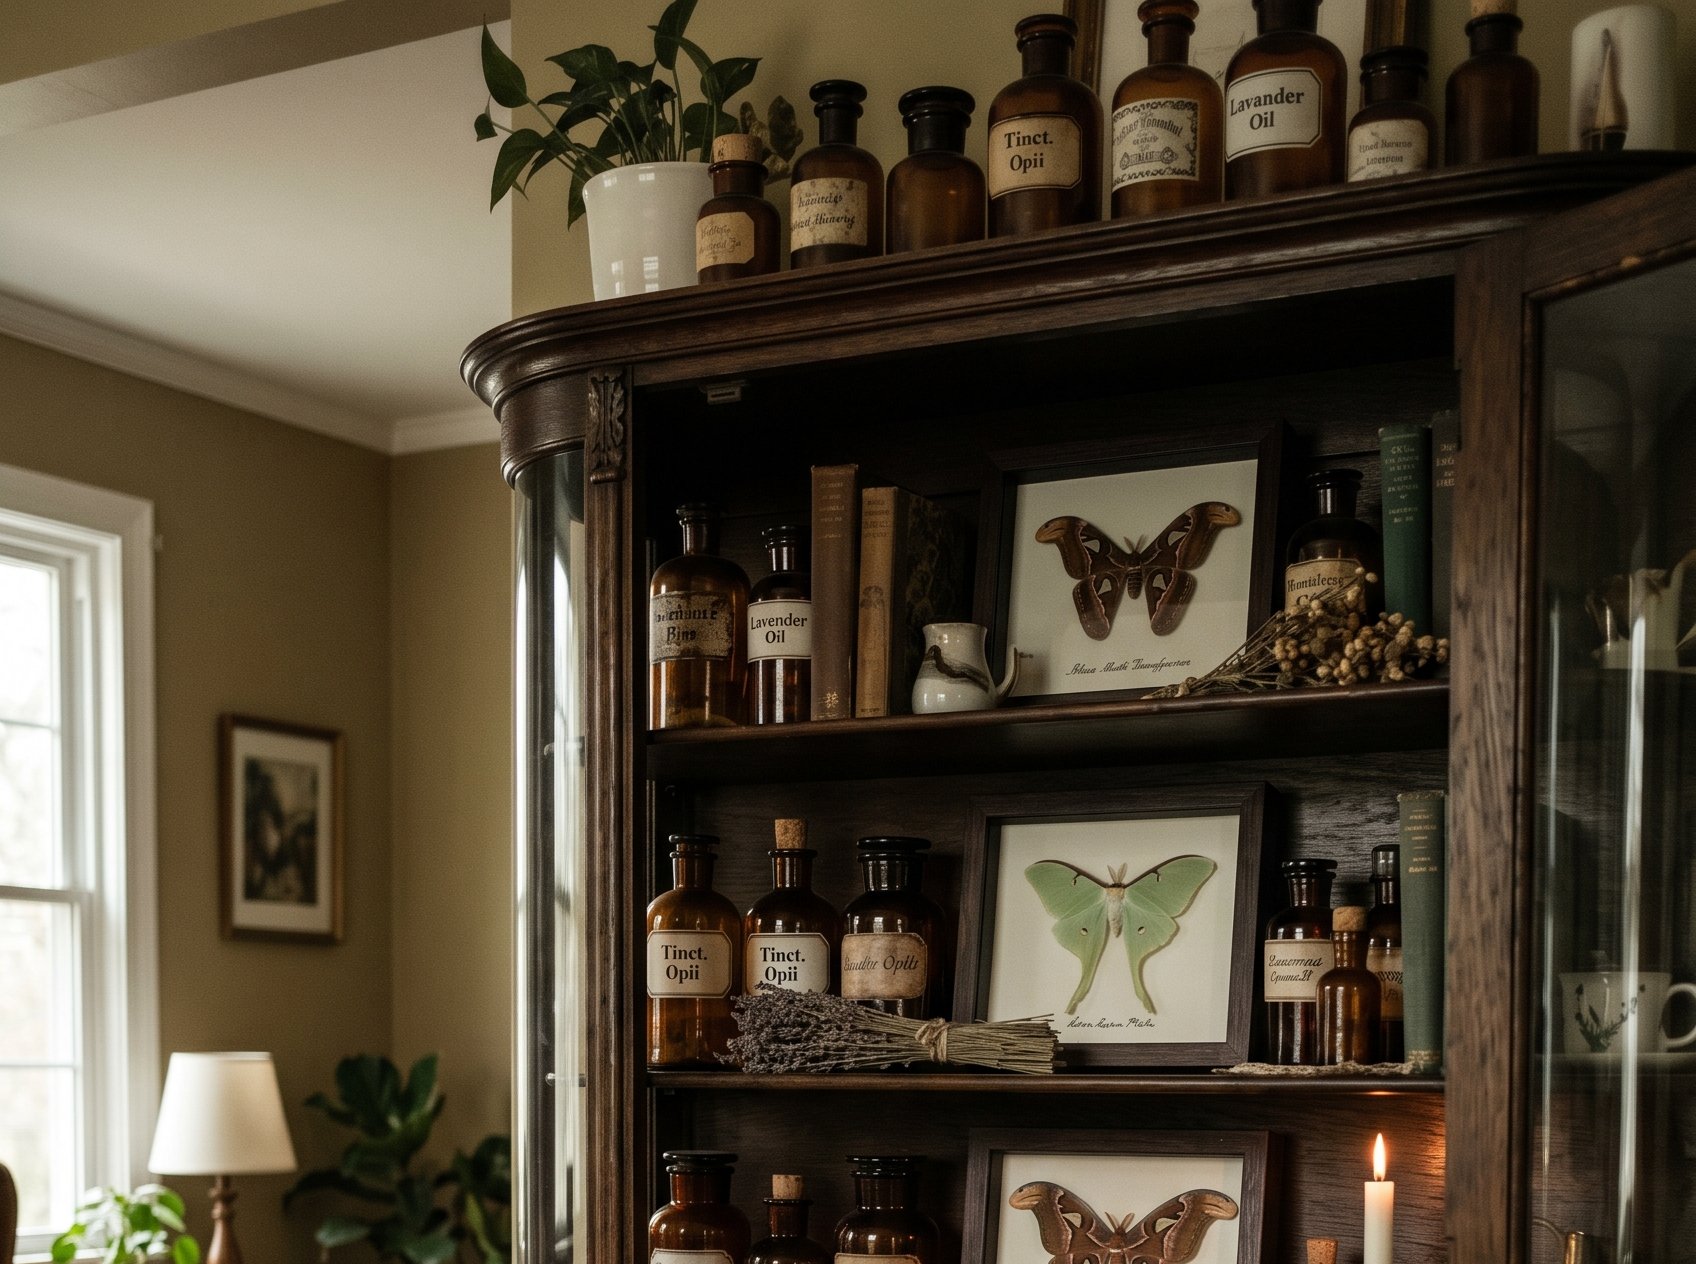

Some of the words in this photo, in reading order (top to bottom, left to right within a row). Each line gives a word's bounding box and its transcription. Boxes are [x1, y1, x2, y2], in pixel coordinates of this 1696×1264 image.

[1230, 87, 1304, 116] Lavander
[1249, 111, 1275, 130] Oil
[1004, 131, 1053, 149] Tinct.
[1010, 153, 1044, 174] Opii
[751, 613, 808, 630] Lavender
[765, 630, 785, 644] Oil
[661, 945, 708, 961] Tinct.
[760, 946, 806, 962] Tinct.
[665, 964, 700, 984] Opii
[764, 966, 798, 984] Opii
